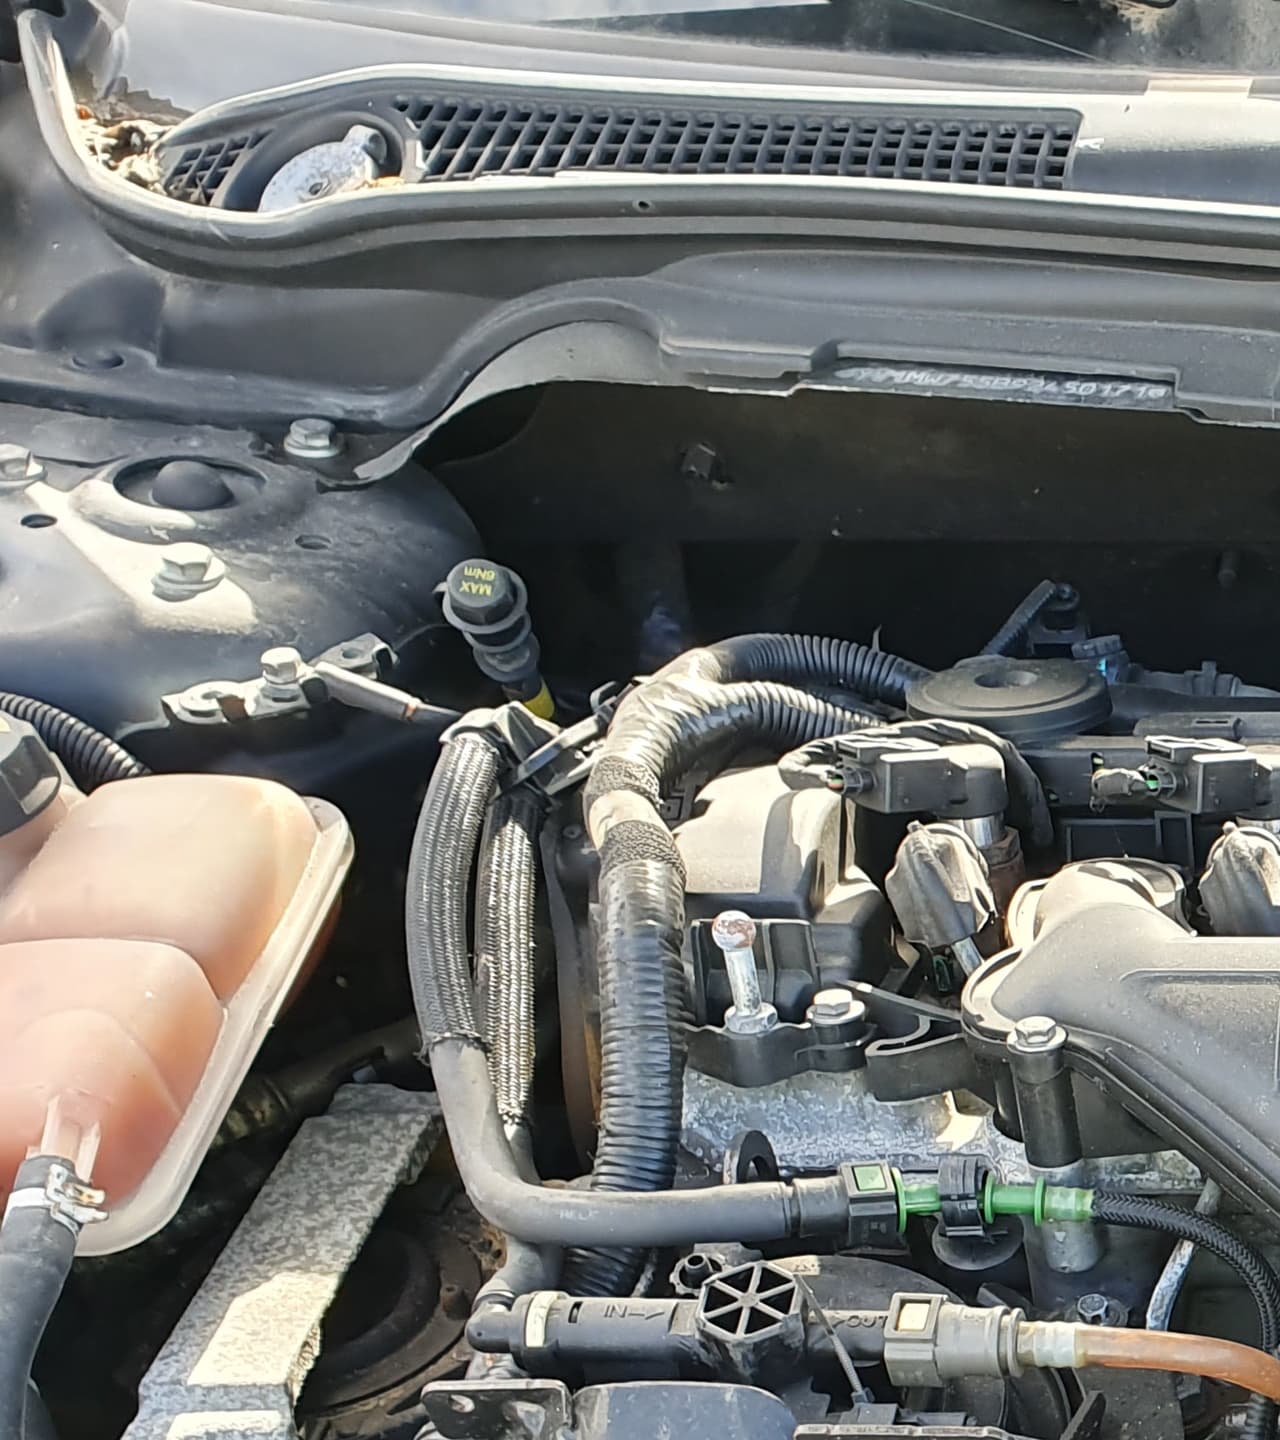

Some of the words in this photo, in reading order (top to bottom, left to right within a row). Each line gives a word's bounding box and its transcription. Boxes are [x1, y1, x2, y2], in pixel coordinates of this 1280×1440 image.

[464, 565, 496, 581] 6Nm
[459, 580, 492, 597] MAX
[847, 1314, 889, 1329] OUT
